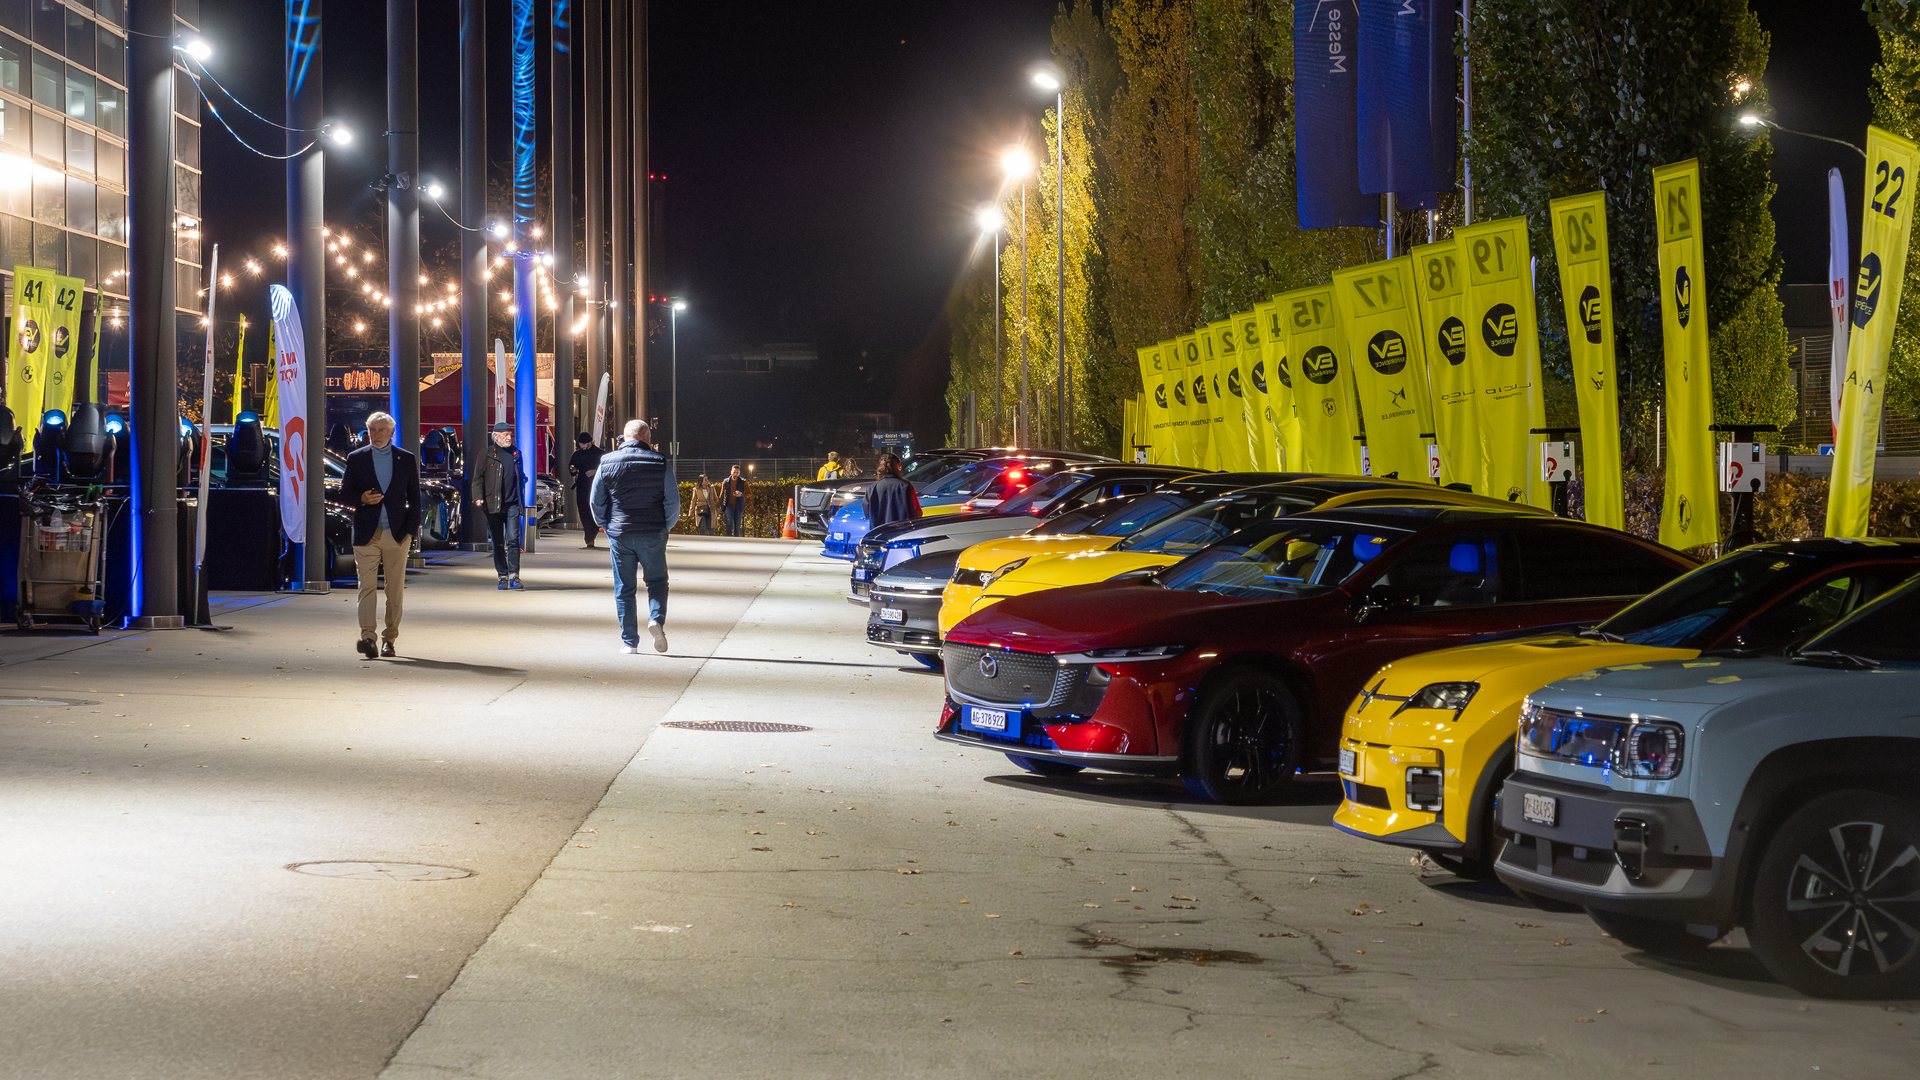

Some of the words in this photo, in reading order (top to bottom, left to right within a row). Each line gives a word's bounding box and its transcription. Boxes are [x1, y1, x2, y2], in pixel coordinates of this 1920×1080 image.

[1871, 160, 1906, 220] 22
[23, 280, 43, 303] 41
[57, 287, 76, 311] 42
[992, 711, 1005, 727] 922
